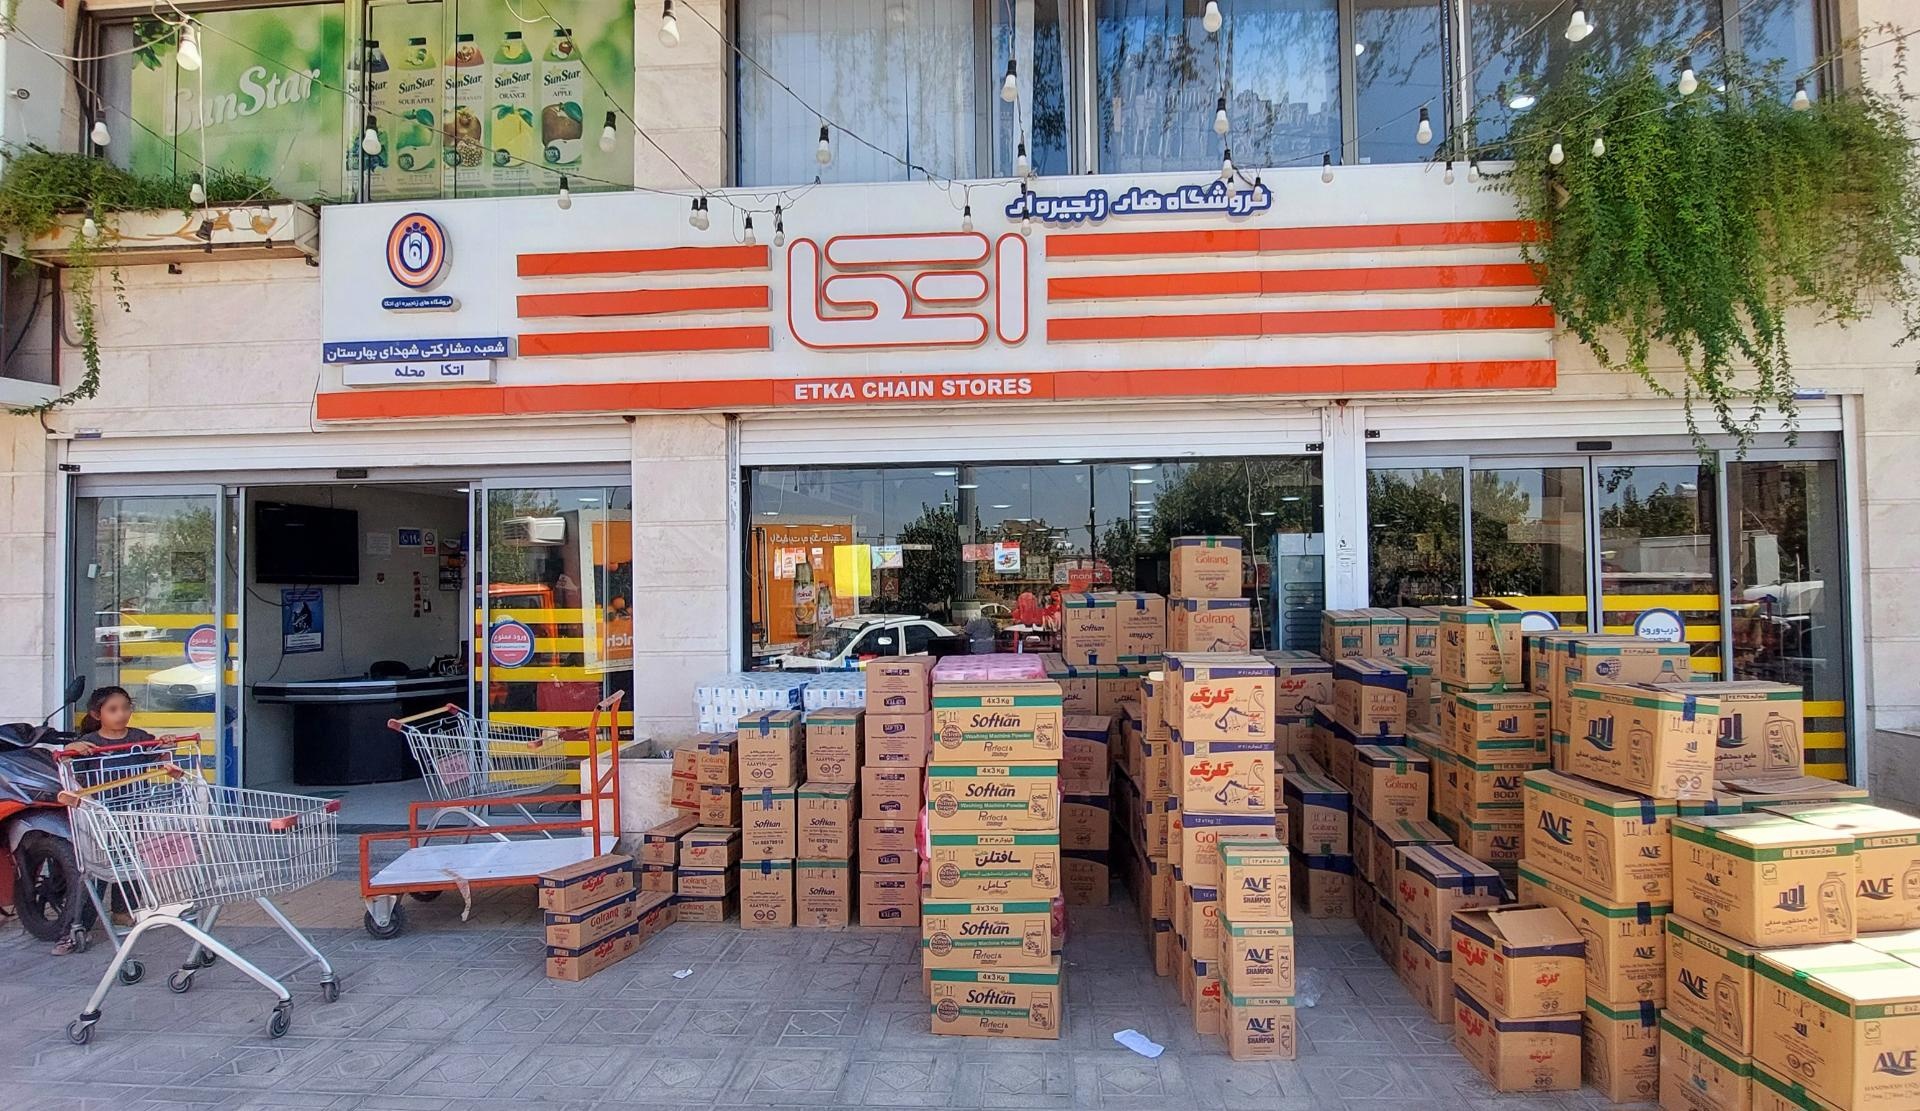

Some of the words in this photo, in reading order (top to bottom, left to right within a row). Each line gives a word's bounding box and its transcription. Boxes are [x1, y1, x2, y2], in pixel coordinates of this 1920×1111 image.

[494, 72, 531, 88] SunStar
[543, 69, 581, 86] SunStar
[398, 77, 434, 94] SunStar
[165, 66, 320, 136] SunStar
[499, 92, 526, 100] ORANGE
[1113, 189, 1161, 213] های
[326, 347, 377, 362] بهارستان
[379, 344, 419, 359] شهدای
[421, 343, 471, 358] مشارکتی
[473, 341, 505, 357] شعبه
[395, 366, 425, 377] محله
[440, 364, 464, 376] اتکا
[794, 382, 856, 400] ETKA
[862, 380, 934, 398] CHAIN
[941, 378, 1033, 397] STORES
[1194, 612, 1236, 625] Golrang
[1447, 630, 1459, 646] AVE
[986, 697, 1000, 705] 4x3
[1001, 697, 1010, 705] Kg
[1190, 687, 1234, 708] گلرنگ
[970, 712, 1020, 728] Softlan
[1714, 752, 1742, 762] دستشوی
[1190, 761, 1234, 781] گلرنگ
[965, 782, 1016, 797] Softlan
[1384, 780, 1418, 792] Golrang
[1493, 775, 1521, 790] AVE
[1493, 791, 1520, 799] BODY
[753, 819, 781, 828] Softlan
[809, 817, 836, 827] Softlan
[1537, 809, 1573, 845] AVE
[1490, 836, 1520, 850] AVE
[690, 848, 708, 858] گلرنگ
[976, 850, 1021, 867] سافتلن
[1490, 850, 1519, 858] BODY
[1638, 845, 1661, 858] AVE
[581, 872, 608, 892] گلرنگ
[982, 880, 1011, 891] کامل
[1242, 877, 1271, 893] AVE
[1704, 872, 1721, 887] AVE
[809, 886, 836, 896] Softlan
[1856, 878, 1894, 900] AVE
[1243, 896, 1271, 904] SHAMPOO
[590, 907, 620, 928] Golrang
[959, 920, 1010, 936] Softlan
[593, 937, 617, 958] گلرنگ
[1456, 938, 1489, 967] گلرنگ
[1633, 946, 1657, 959] AVE
[1245, 948, 1274, 963] AVE
[1246, 967, 1274, 975] SHAMPOO
[1535, 972, 1560, 987] گلرنگ
[1678, 967, 1709, 1000] AVE
[966, 990, 1016, 1006] Softlan
[1246, 1017, 1275, 1033] AVE
[1458, 1007, 1485, 1037] گلرنگ
[1247, 1036, 1275, 1044] SHAMPOO
[1529, 1050, 1556, 1064] گلرنگ
[1873, 1049, 1918, 1076] AVE
